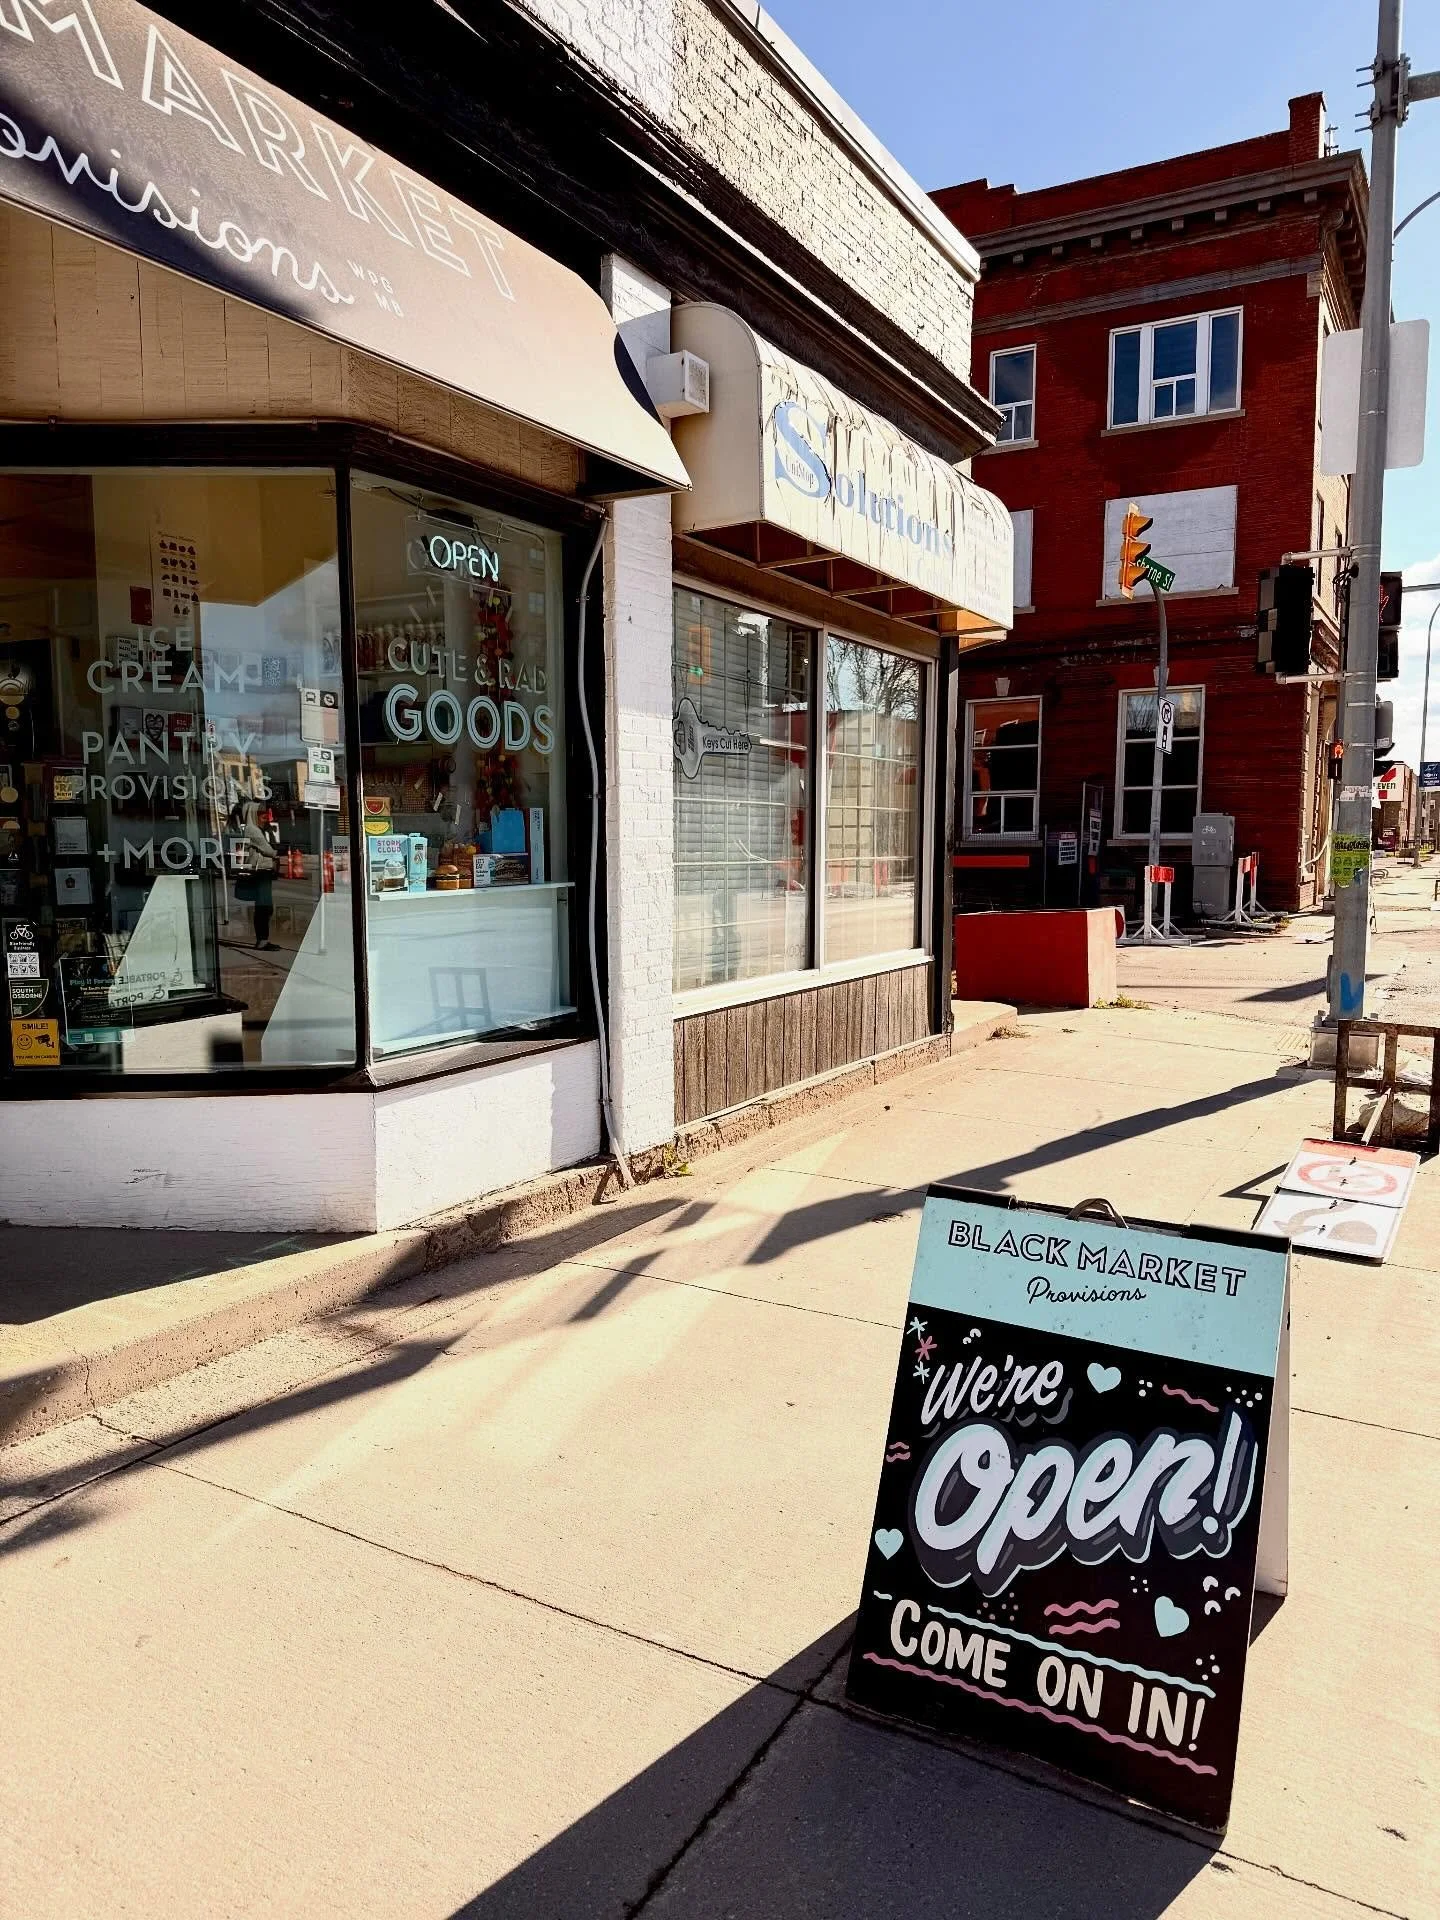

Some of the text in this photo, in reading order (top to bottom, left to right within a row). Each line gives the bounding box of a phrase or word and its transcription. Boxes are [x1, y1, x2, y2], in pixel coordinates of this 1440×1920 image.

[346, 259, 393, 294] WPG
[374, 292, 404, 318] MB
[430, 535, 500, 582] OPEN
[1162, 573, 1173, 590] St
[137, 627, 193, 652] ICE
[86, 660, 246, 693] CREAM
[387, 636, 547, 694] CUTE & RAD
[385, 683, 555, 755] GOODS
[81, 731, 256, 765] PANTRY
[702, 736, 749, 751] Keys Cut Here
[73, 774, 273, 801] PROVISIONS
[97, 837, 253, 869] +MORE
[21, 1022, 49, 1031] SMILE!
[948, 1220, 1248, 1297] BLACK MARKET
[1026, 1276, 1147, 1305] Provisions
[920, 1355, 1065, 1424] We're
[914, 1409, 1244, 1575] Open!
[890, 1600, 1206, 1753] COME ON IN!
